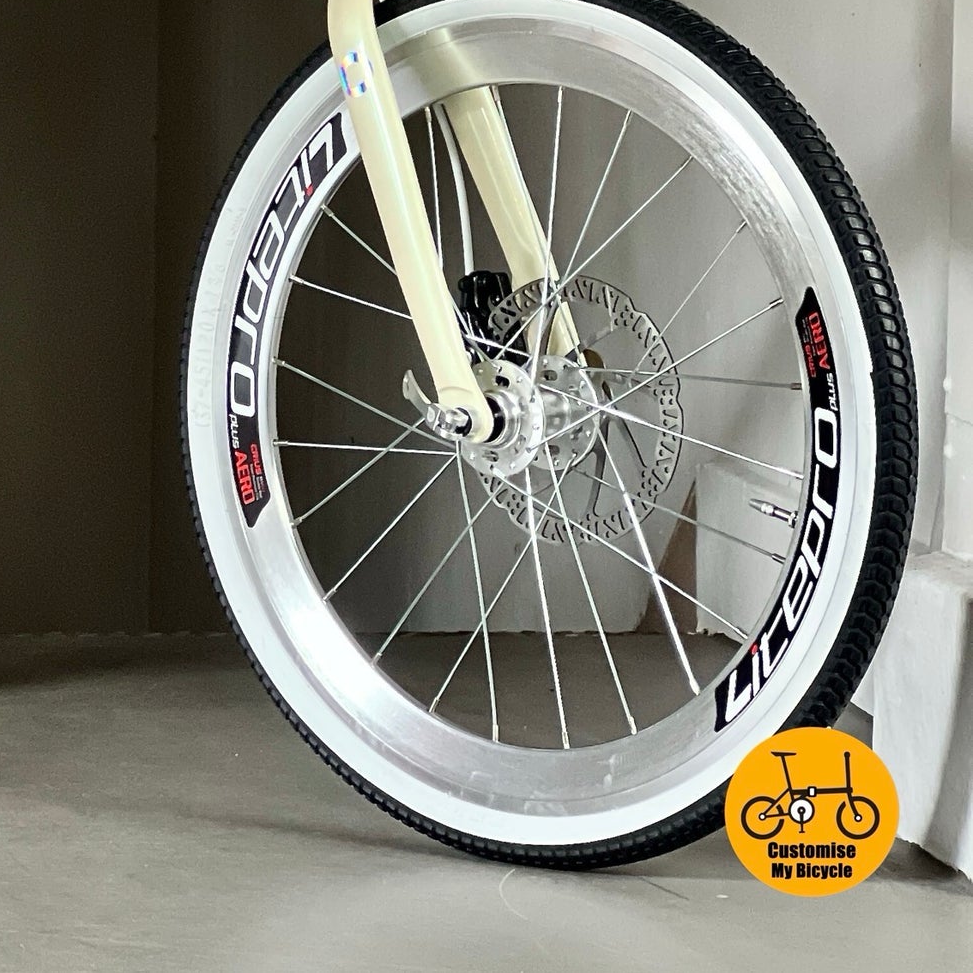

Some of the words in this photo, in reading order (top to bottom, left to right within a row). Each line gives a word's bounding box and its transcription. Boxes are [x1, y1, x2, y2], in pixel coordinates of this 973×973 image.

[230, 121, 334, 418] Litepro
[234, 450, 256, 506] AERO
[725, 406, 838, 723] Litepro
[808, 311, 831, 371] AERO
